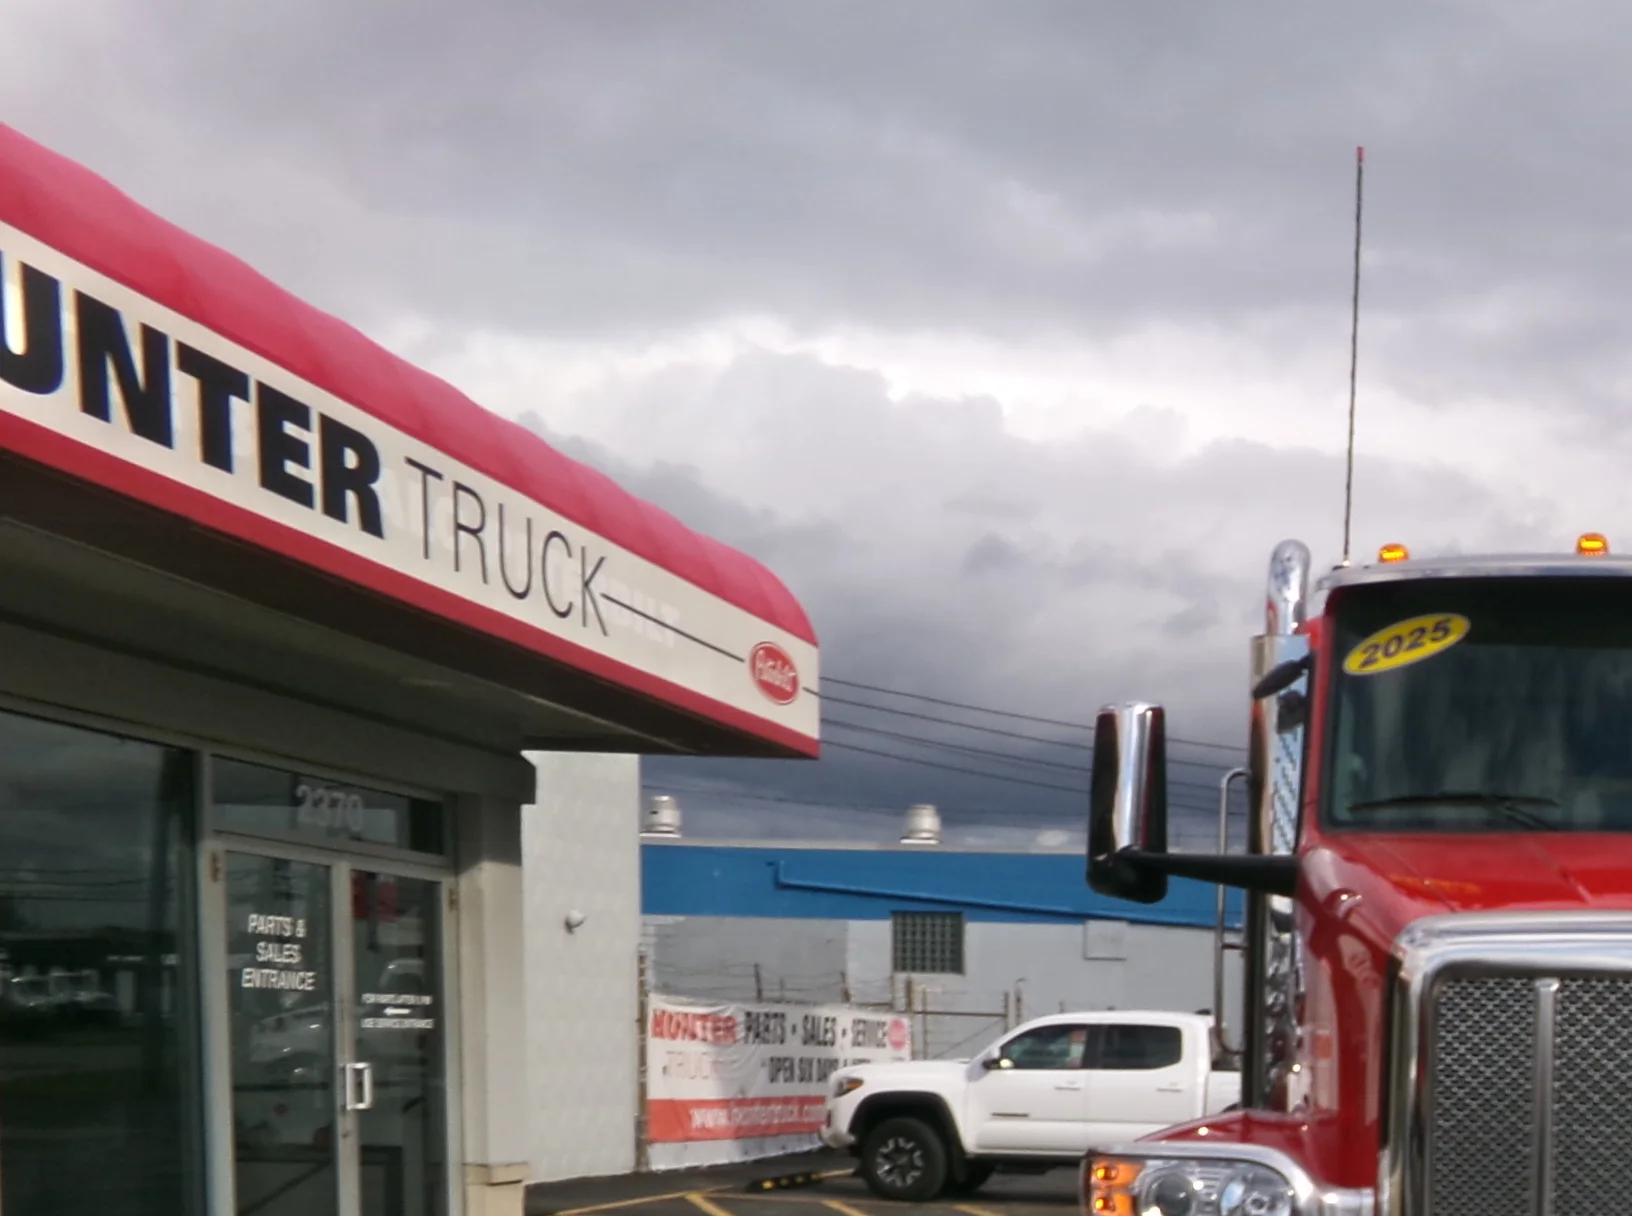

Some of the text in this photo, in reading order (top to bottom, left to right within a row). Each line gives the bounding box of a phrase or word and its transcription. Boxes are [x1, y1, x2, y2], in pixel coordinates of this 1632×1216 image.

[404, 456, 608, 637] TRUCK
[1358, 618, 1452, 670] 2025
[248, 913, 307, 938] PARTS &
[255, 942, 302, 963] SALES
[241, 968, 316, 990] ENTRANCE
[744, 1011, 787, 1045] PARTS
[802, 1014, 837, 1047] SALES
[769, 1056, 795, 1083] OPEN
[798, 1057, 813, 1083] SIX
